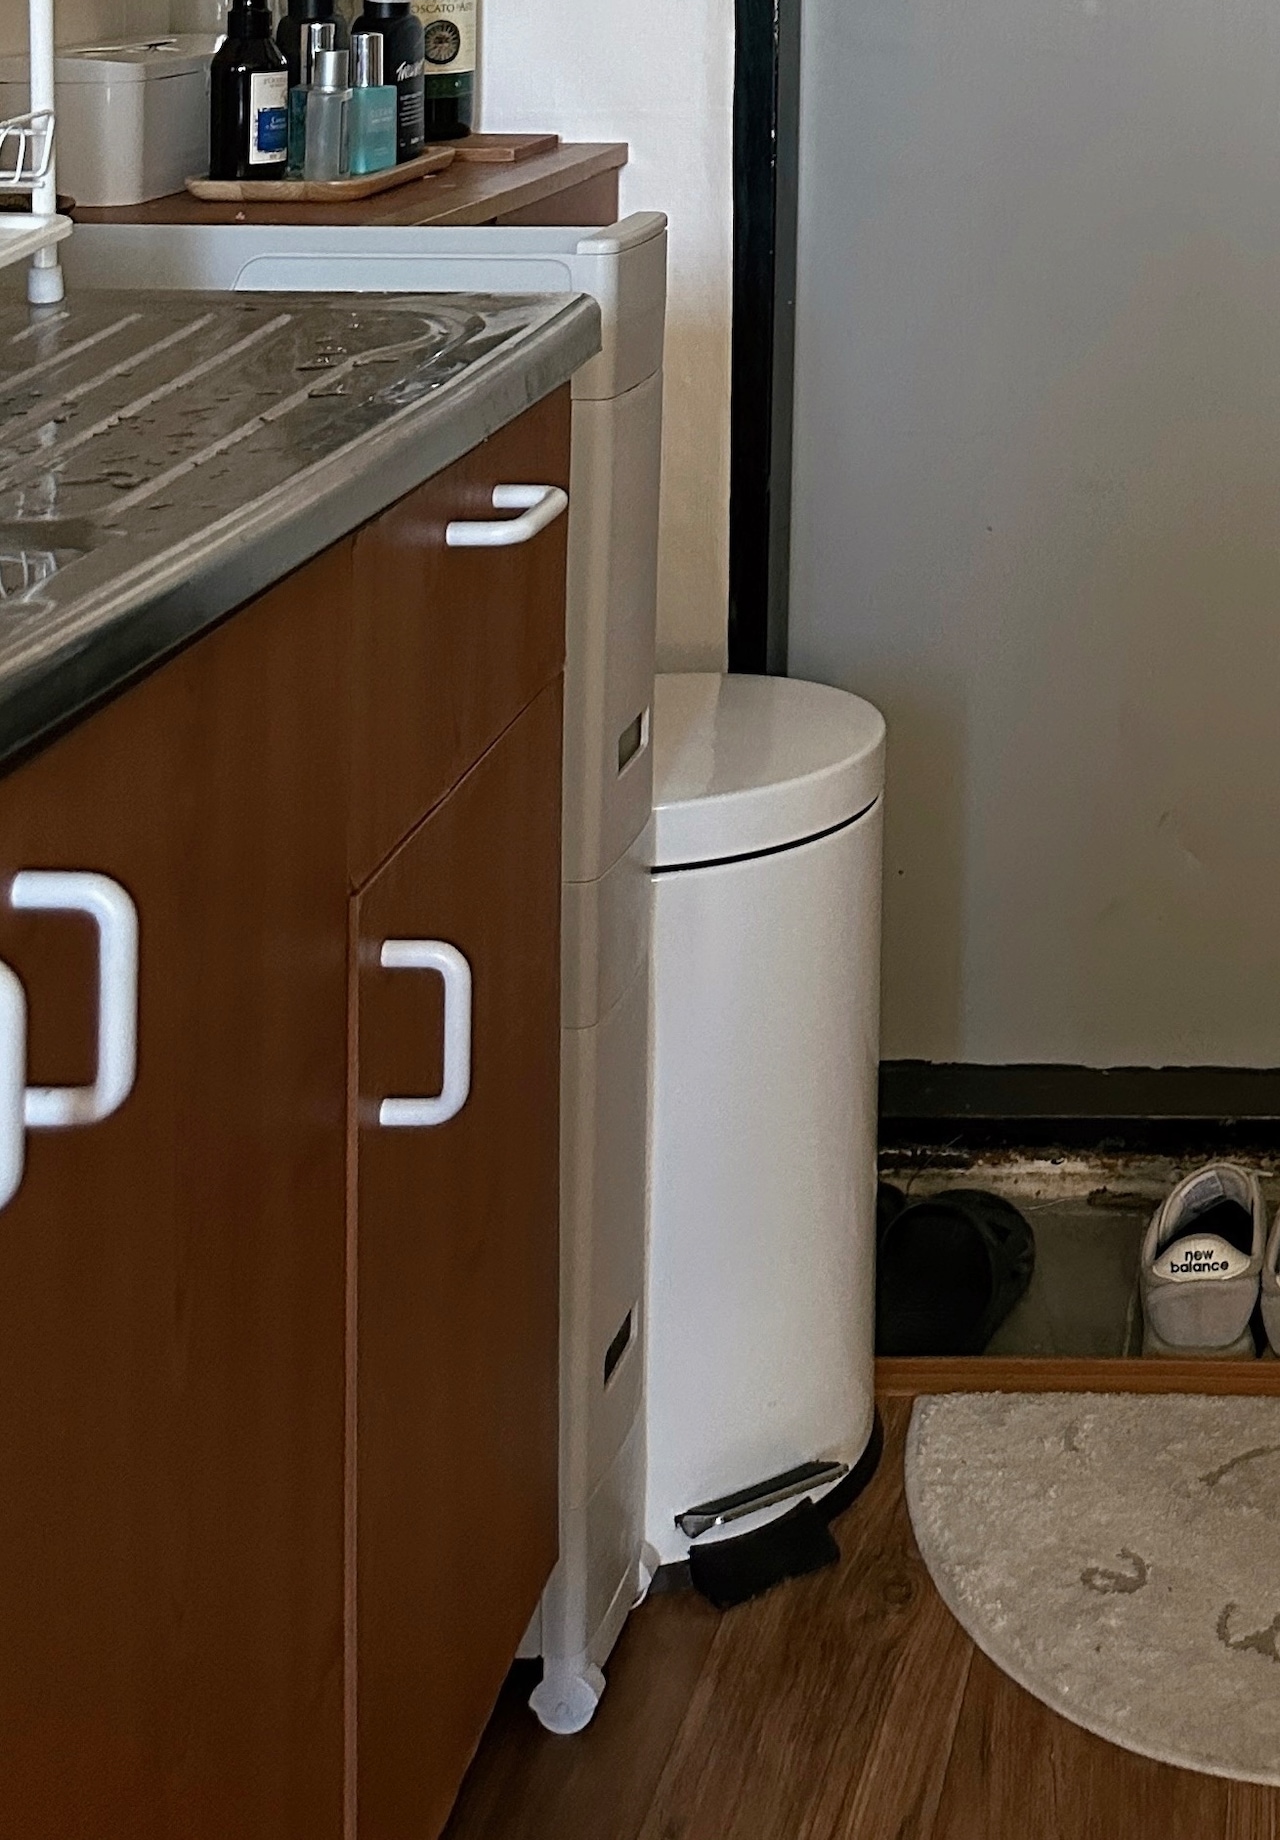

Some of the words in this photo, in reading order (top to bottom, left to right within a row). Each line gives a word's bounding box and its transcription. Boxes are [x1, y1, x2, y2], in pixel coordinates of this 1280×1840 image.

[410, 3, 455, 13] OSCATO
[1185, 1250, 1214, 1260] new
[1170, 1261, 1229, 1273] balance
